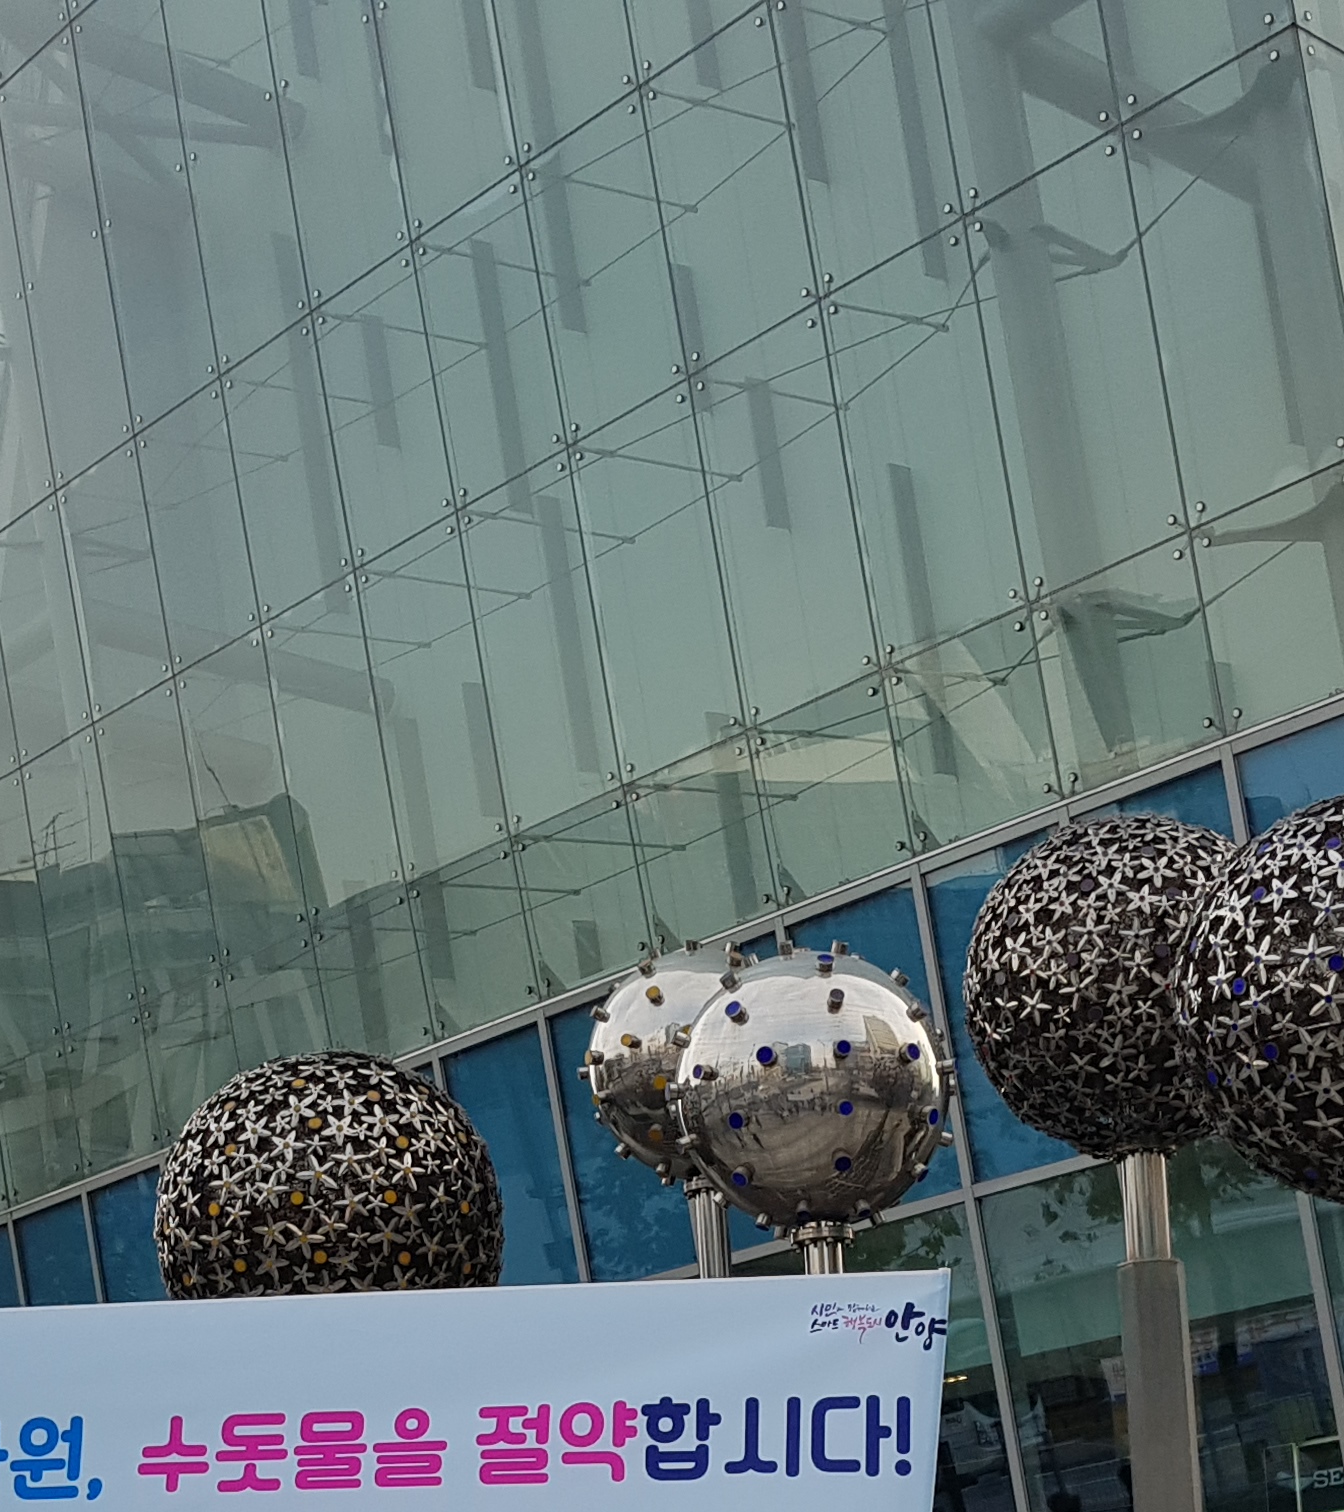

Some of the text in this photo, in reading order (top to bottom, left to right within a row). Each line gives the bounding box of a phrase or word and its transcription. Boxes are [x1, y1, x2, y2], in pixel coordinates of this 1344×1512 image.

[885, 1302, 947, 1350] 안양
[138, 1407, 448, 1493] 수돗물을
[476, 1395, 911, 1485] 절약합시다!
